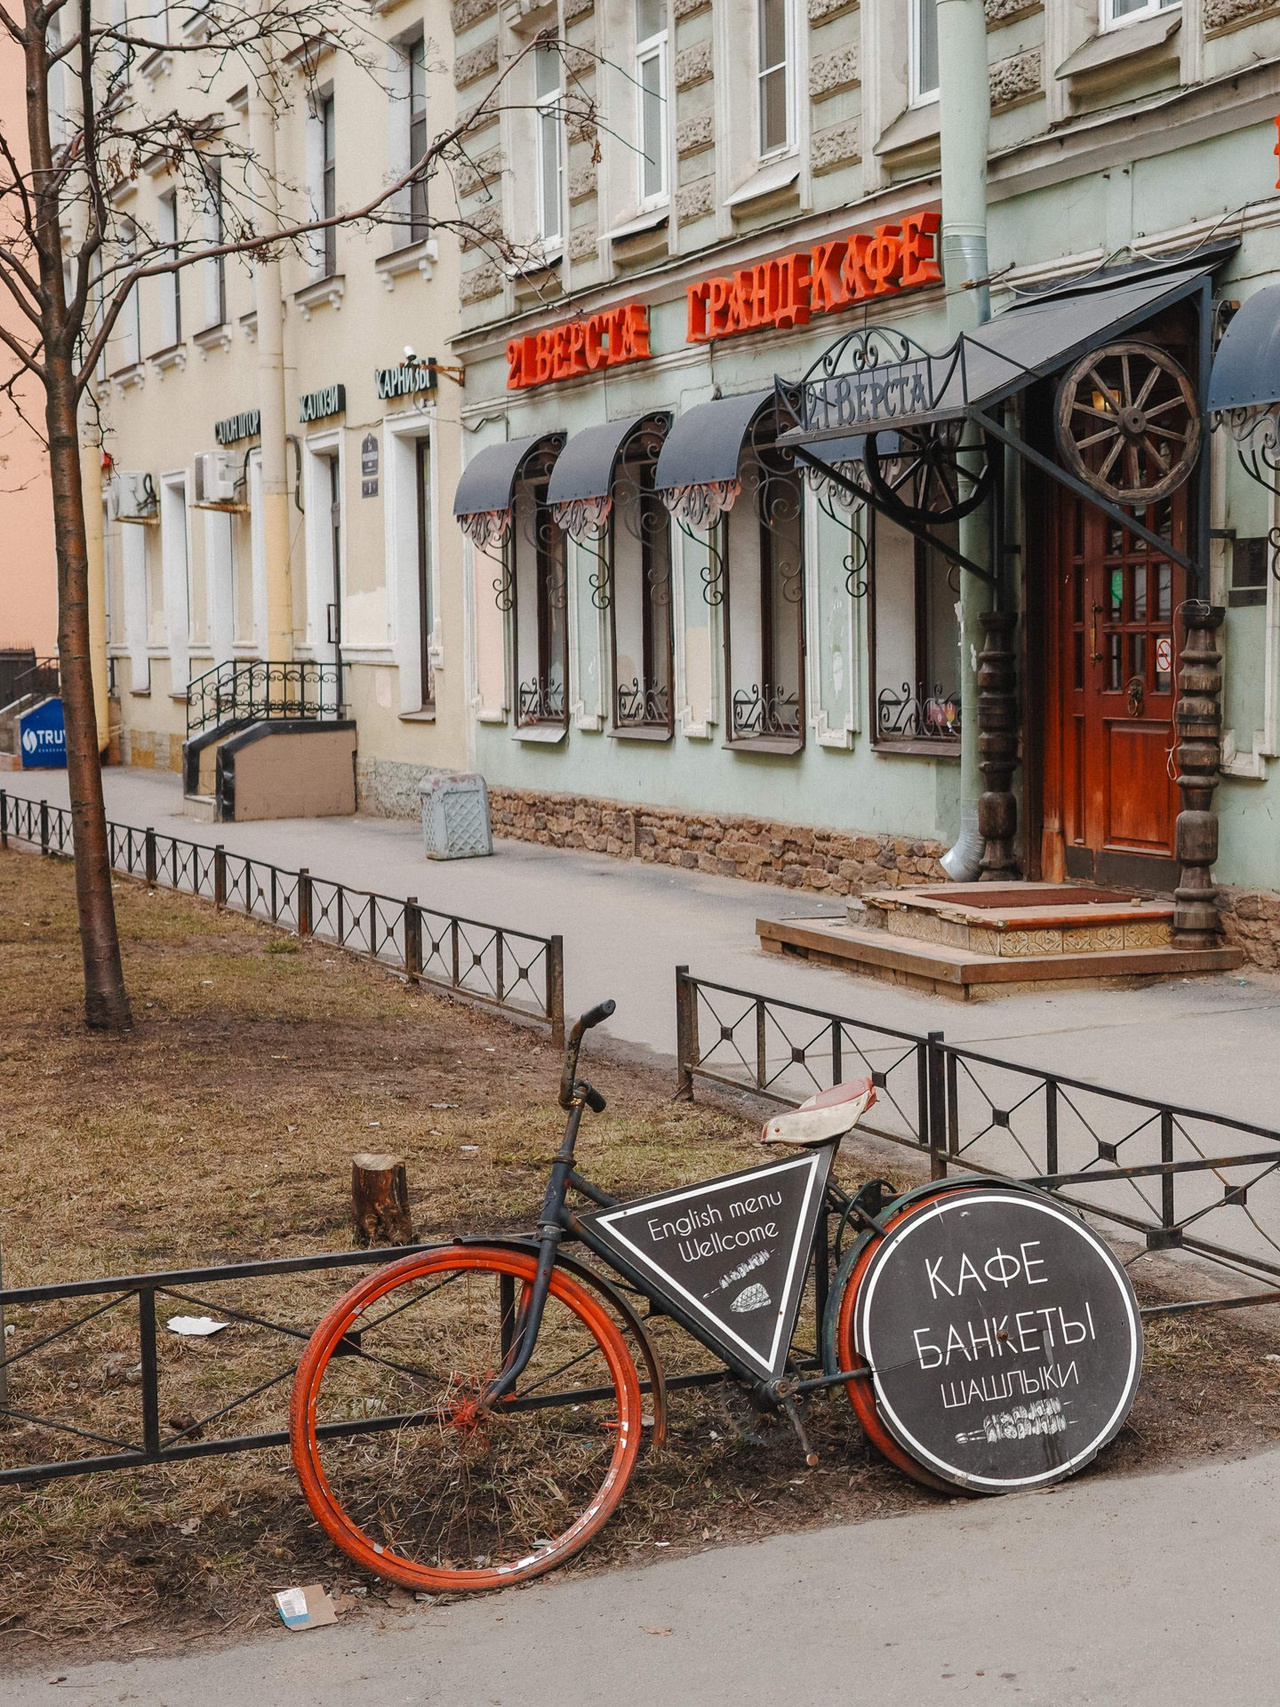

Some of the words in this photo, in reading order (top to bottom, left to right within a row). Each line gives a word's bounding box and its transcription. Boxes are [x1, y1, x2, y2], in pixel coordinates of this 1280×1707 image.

[685, 211, 943, 347] ГРАНД-КАФЕ
[506, 336, 538, 390] 21
[534, 304, 652, 387] ВЕРСТА
[299, 384, 339, 422] ЖАЛЮЗИ
[375, 359, 430, 399] КАРНИЗЫ
[239, 409, 259, 438] ШТОР
[647, 1204, 723, 1242] English
[729, 1191, 783, 1218] menu
[678, 1222, 780, 1263] Wellcome
[924, 1241, 1049, 1300] КАФЕ
[913, 1302, 1096, 1370] БАНКЕТЫ
[940, 1361, 1079, 1409] ШАШЛЫКИ
